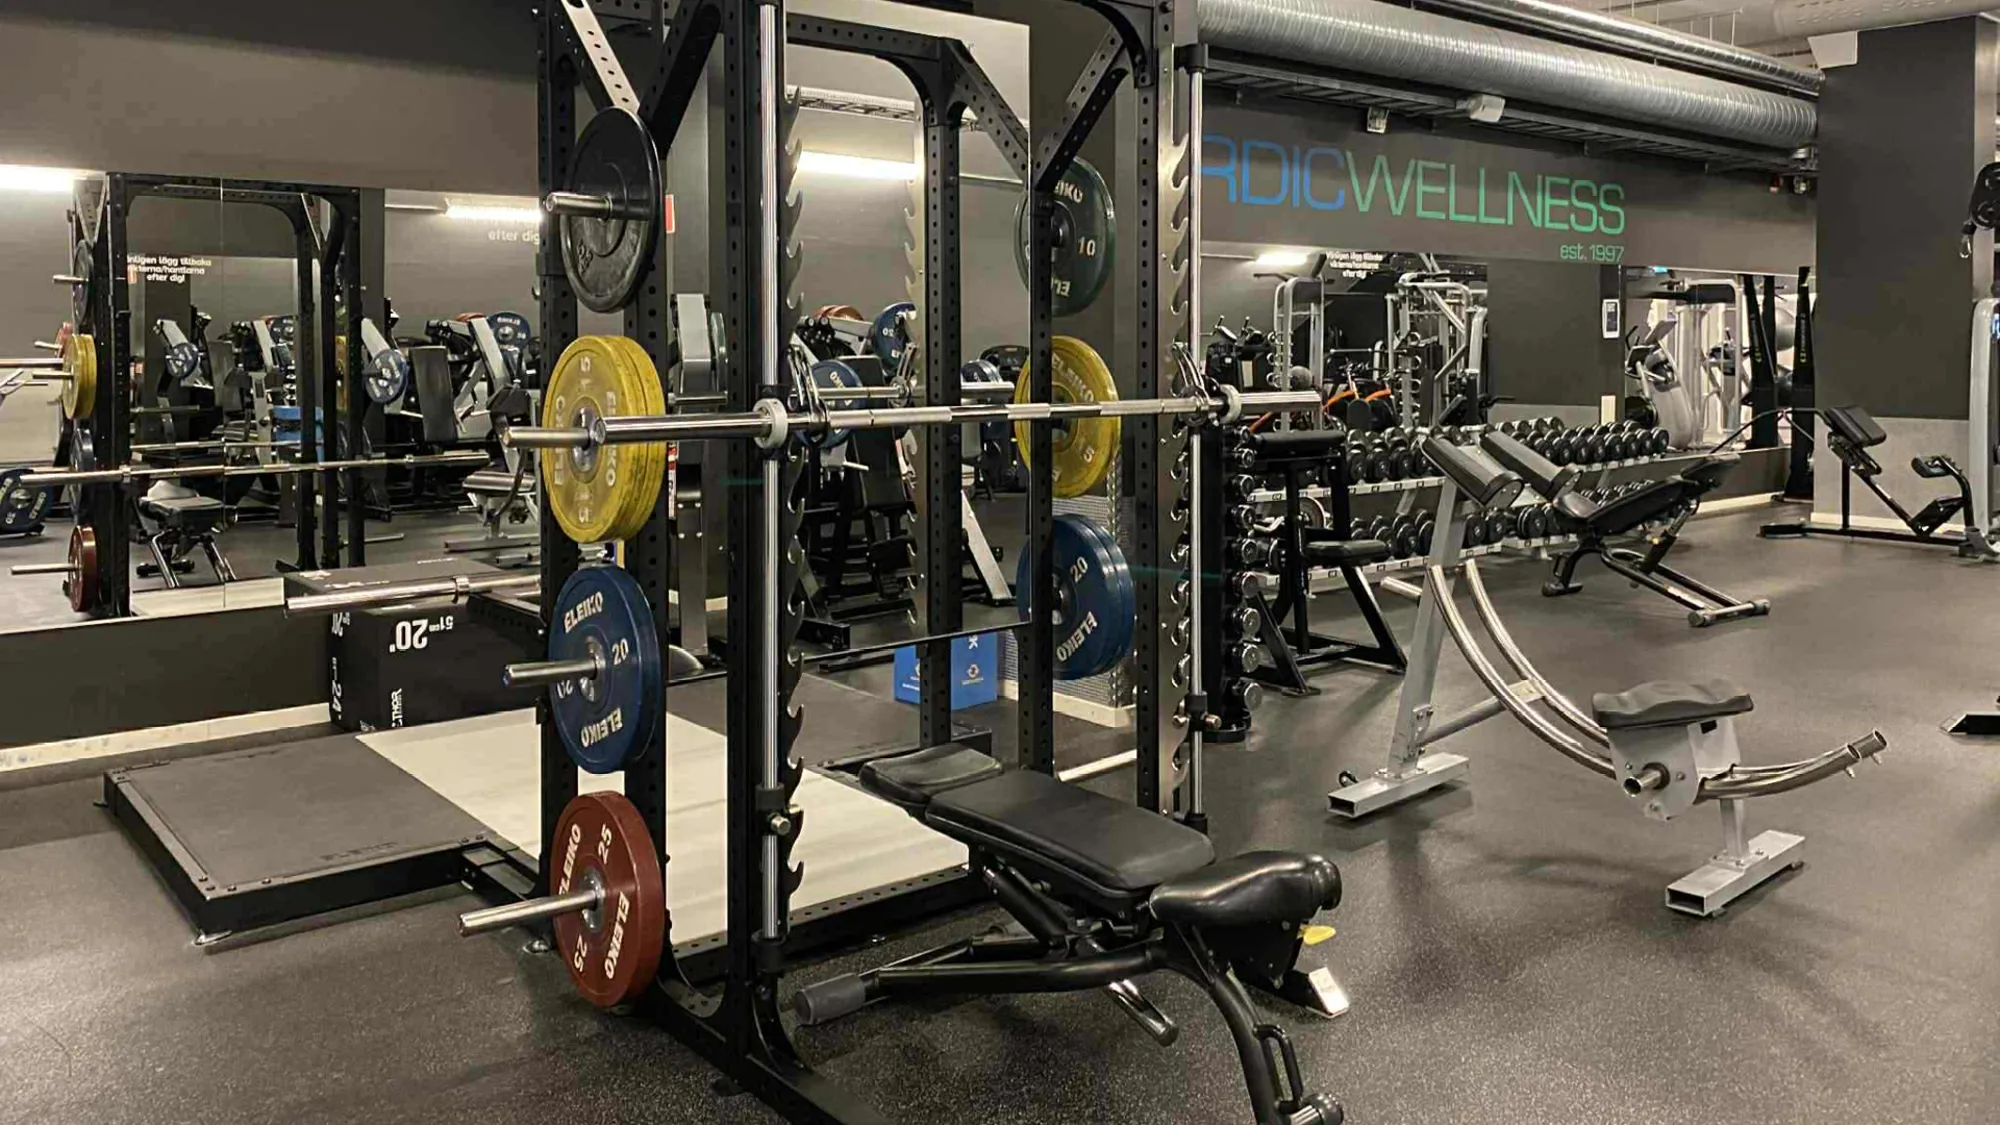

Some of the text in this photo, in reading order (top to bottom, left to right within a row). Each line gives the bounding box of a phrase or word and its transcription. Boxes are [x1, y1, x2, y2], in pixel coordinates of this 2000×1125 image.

[1054, 180, 1083, 203] IKO
[1345, 150, 1625, 235] WELLNESS
[1077, 236, 1096, 257] 10
[1560, 243, 1625, 263] est. 1997
[1070, 556, 1089, 583] 20
[564, 591, 603, 633] ELEIKO
[612, 638, 629, 665] 20
[1056, 611, 1098, 662] ELEIKO
[581, 707, 623, 747] ELEIKO
[598, 823, 612, 865] 25
[573, 934, 588, 972] 25
[604, 891, 629, 980] ELEIKO
